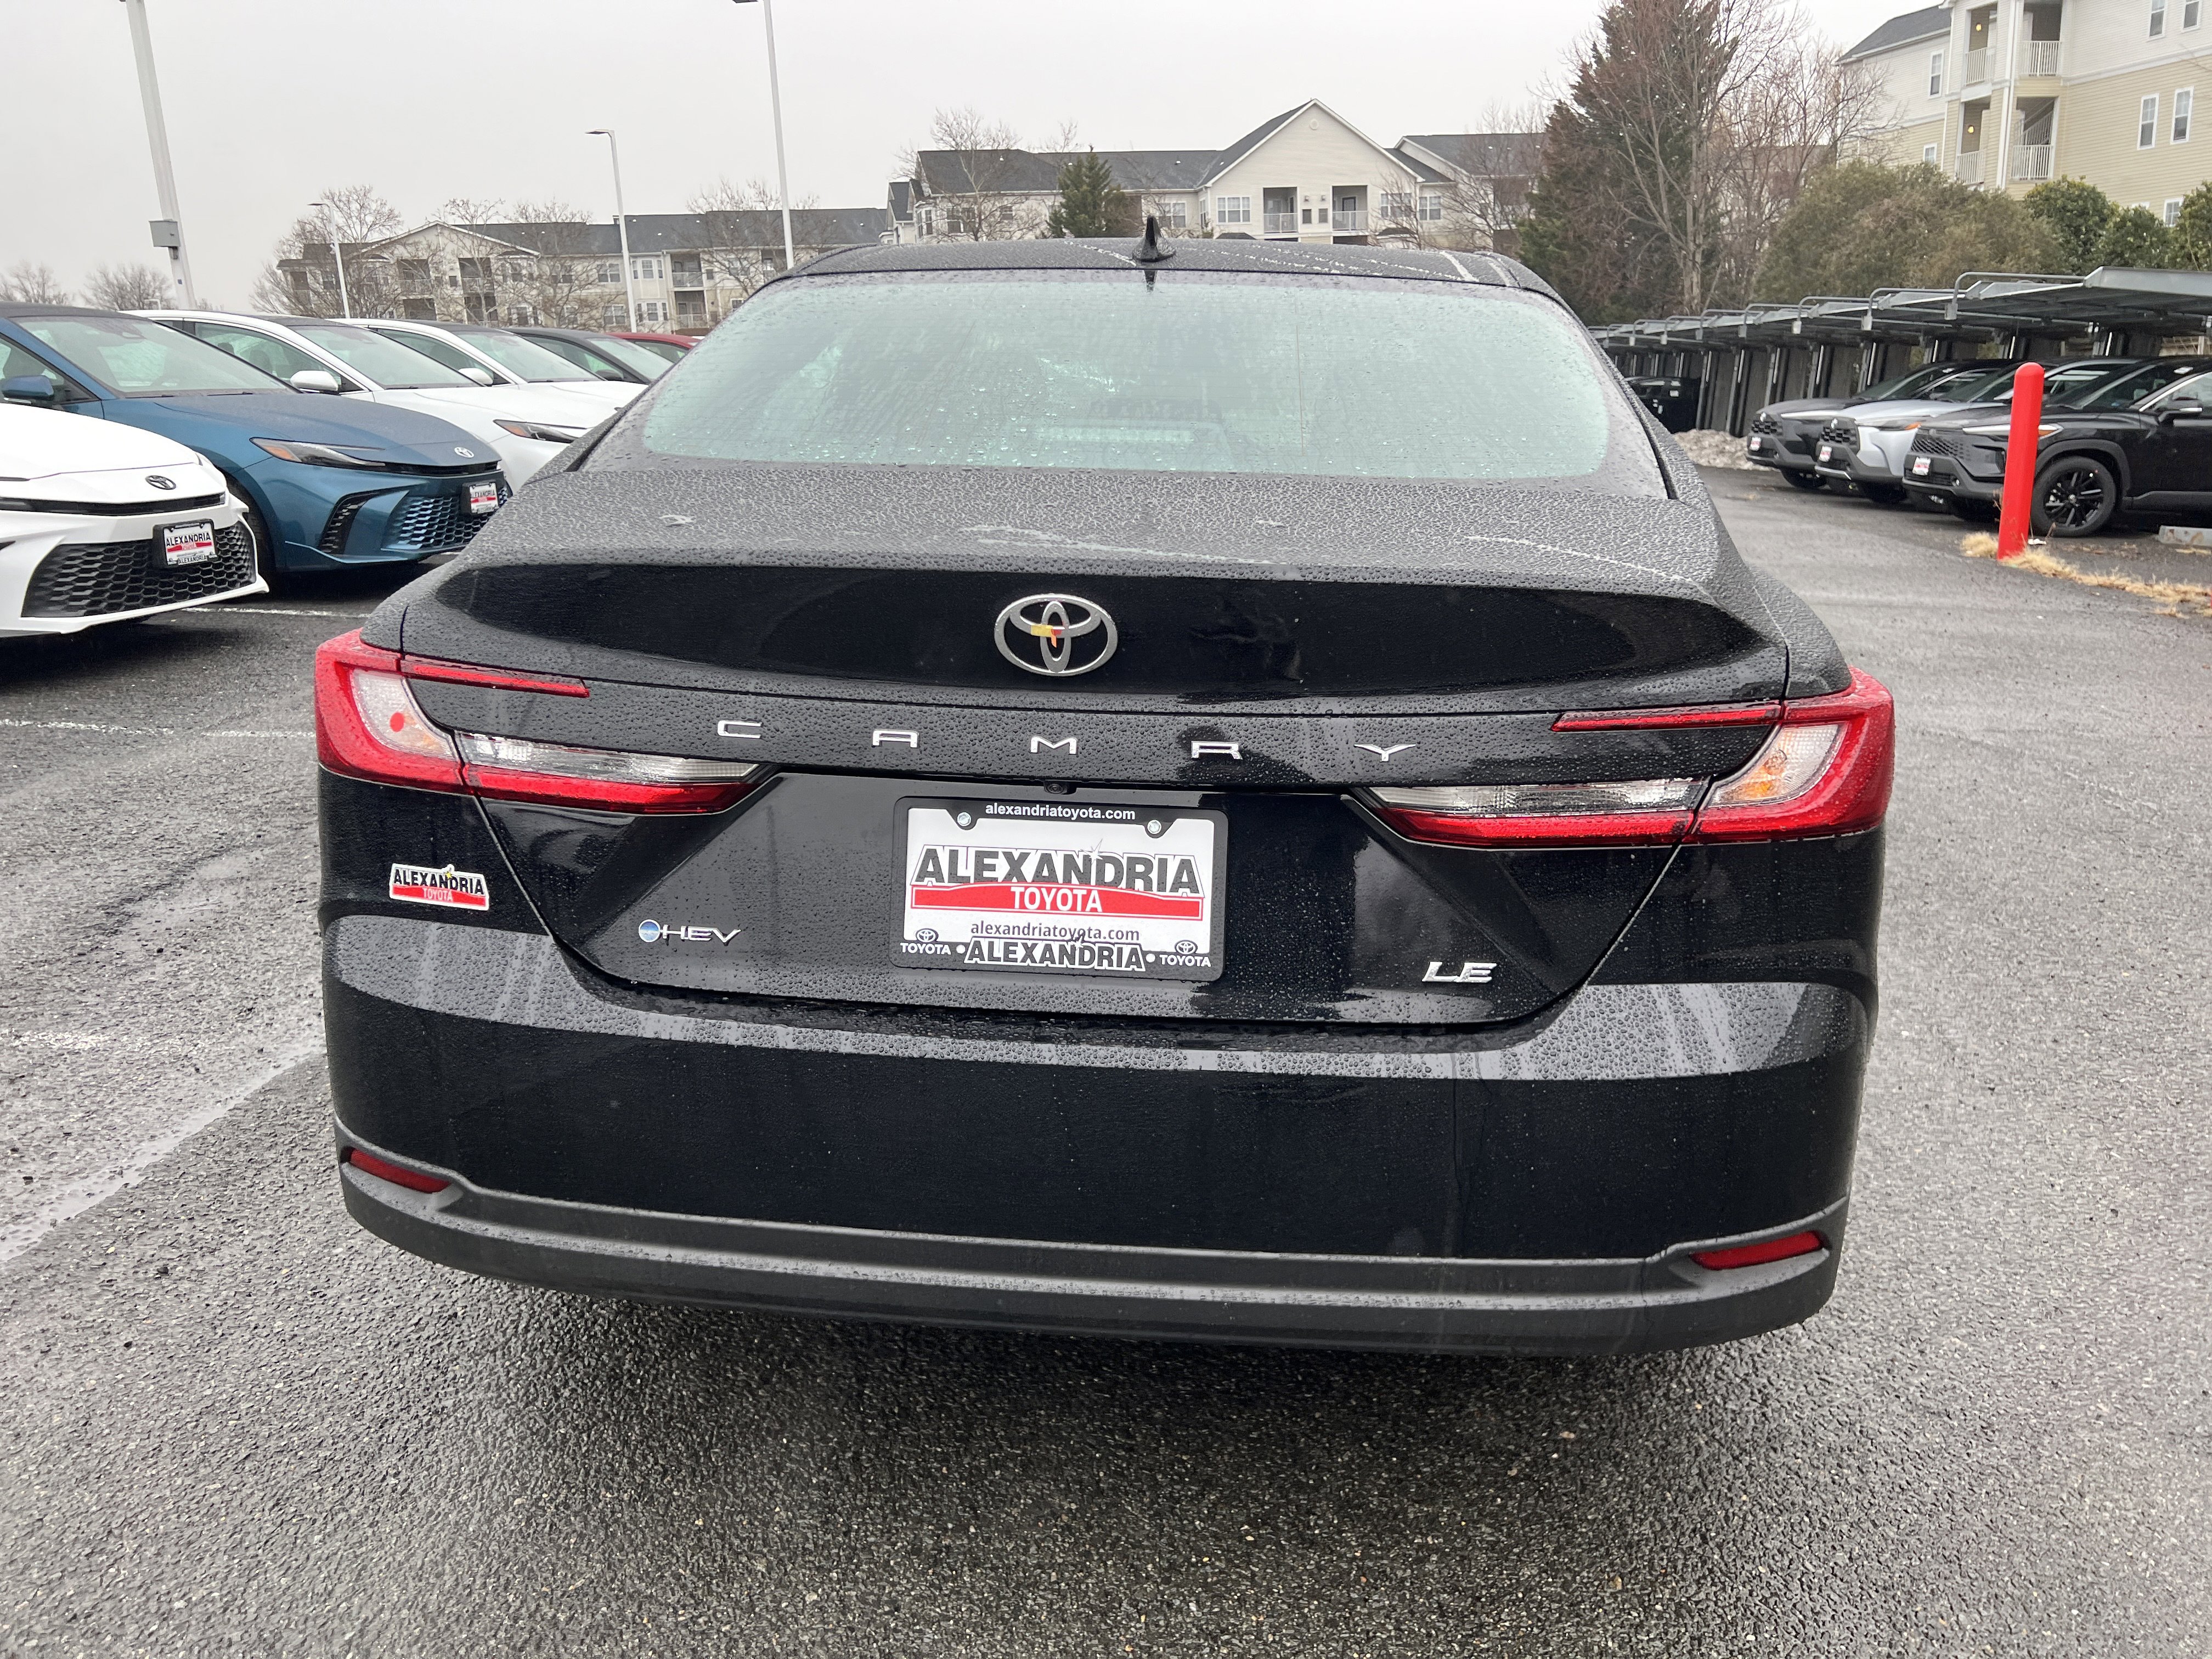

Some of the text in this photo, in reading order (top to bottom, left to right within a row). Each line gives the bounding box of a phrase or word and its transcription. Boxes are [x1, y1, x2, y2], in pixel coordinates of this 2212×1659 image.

[166, 532, 211, 547] ALEXANDRIA
[178, 555, 207, 565] ALEXANDRIA
[717, 719, 1417, 763] CAMRY
[985, 802, 1136, 820] alexandriatoyota.com
[393, 868, 484, 895] ALEXANDRIA
[914, 847, 1200, 894] ALEXANDRIA
[422, 887, 454, 902] TOYOTA
[1010, 886, 1103, 912] TOYOTA
[662, 924, 742, 943] HEV
[970, 919, 1140, 941] alexandriatoyota.com
[900, 938, 1212, 970] TOYOTA ALEXANDRIA TOYOTA
[1421, 961, 1498, 983] LE
